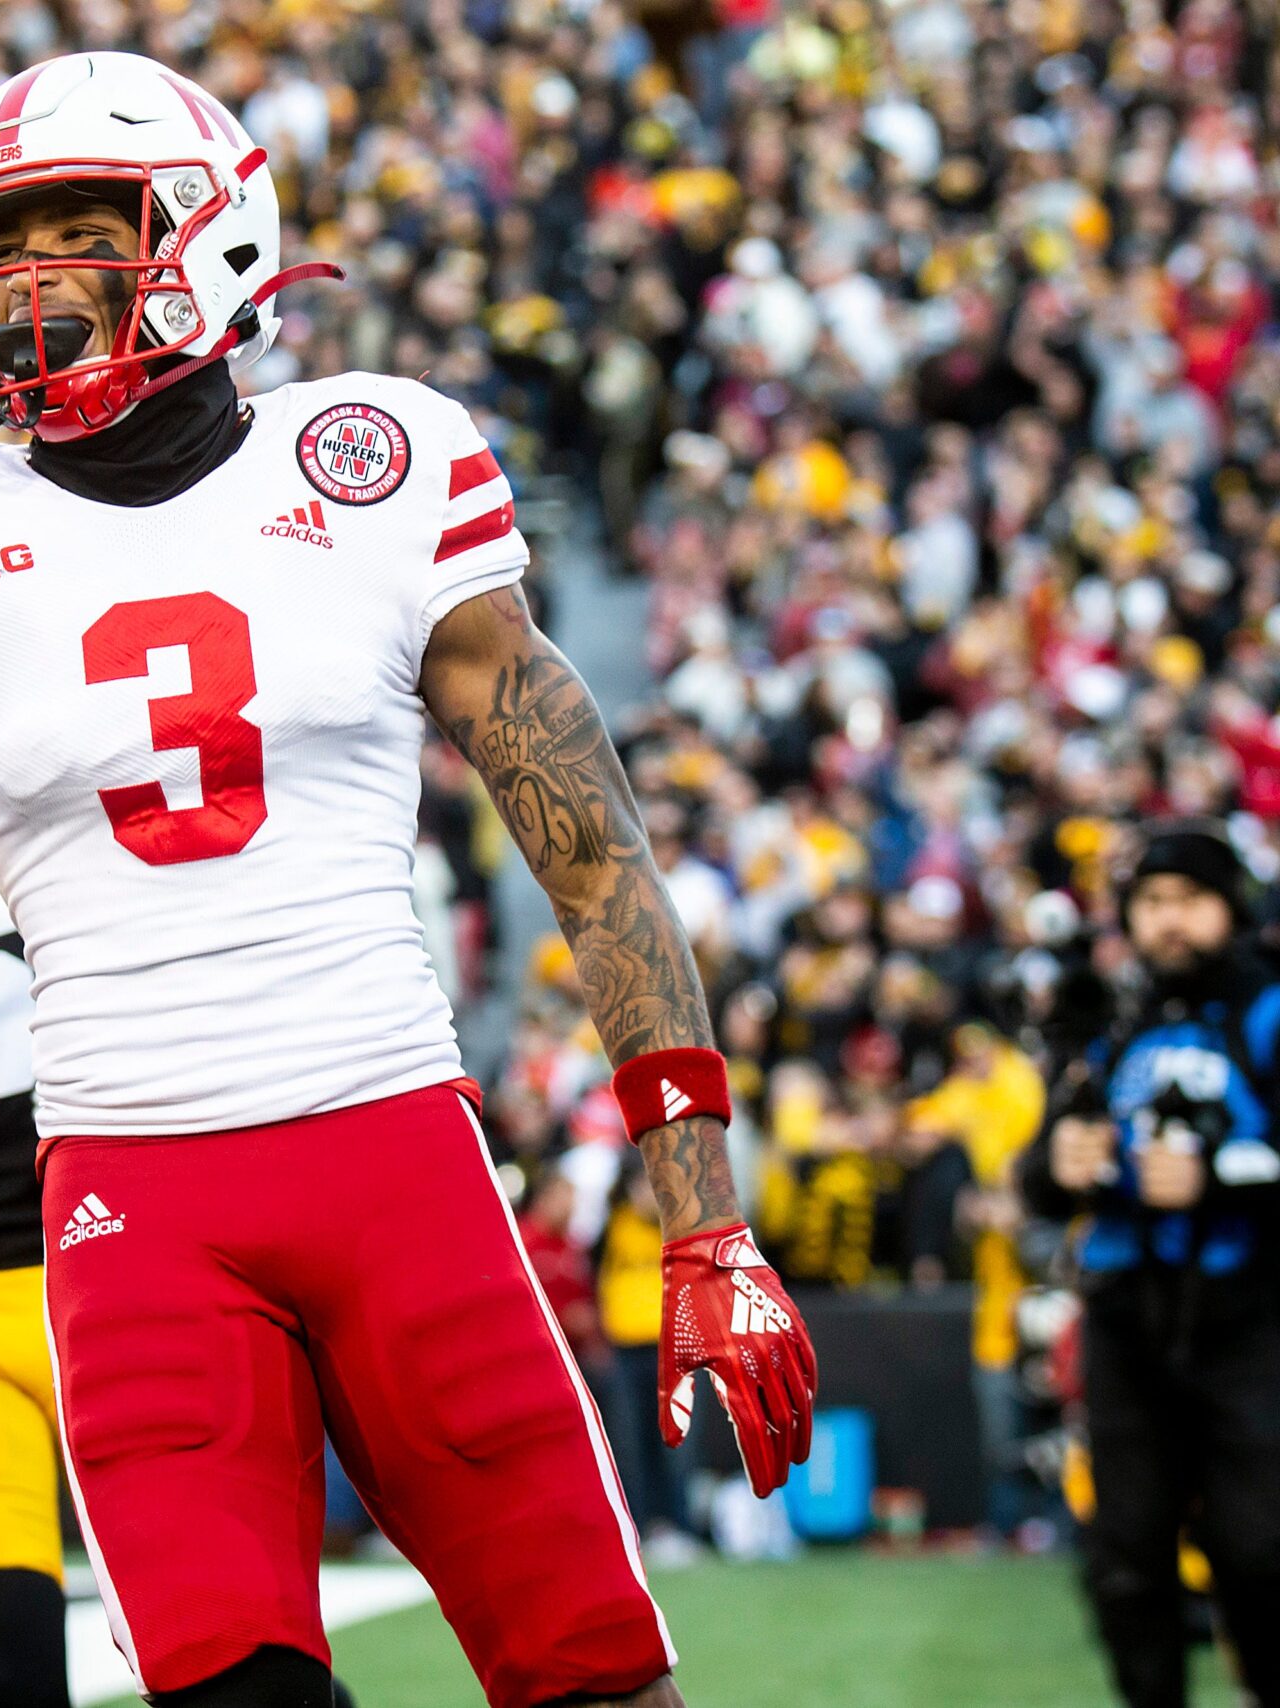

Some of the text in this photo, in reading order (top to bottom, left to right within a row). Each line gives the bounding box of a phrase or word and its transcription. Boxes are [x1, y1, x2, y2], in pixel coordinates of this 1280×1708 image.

[307, 405, 405, 457] NEBRASKA FOOTBALL
[321, 438, 385, 466] HUSKERS
[303, 456, 341, 496] WINNING
[347, 468, 400, 501] TRADITION
[260, 522, 334, 549] adidas
[82, 591, 268, 867] 3
[59, 1218, 125, 1251] adidas
[730, 1268, 793, 1330] adidas
